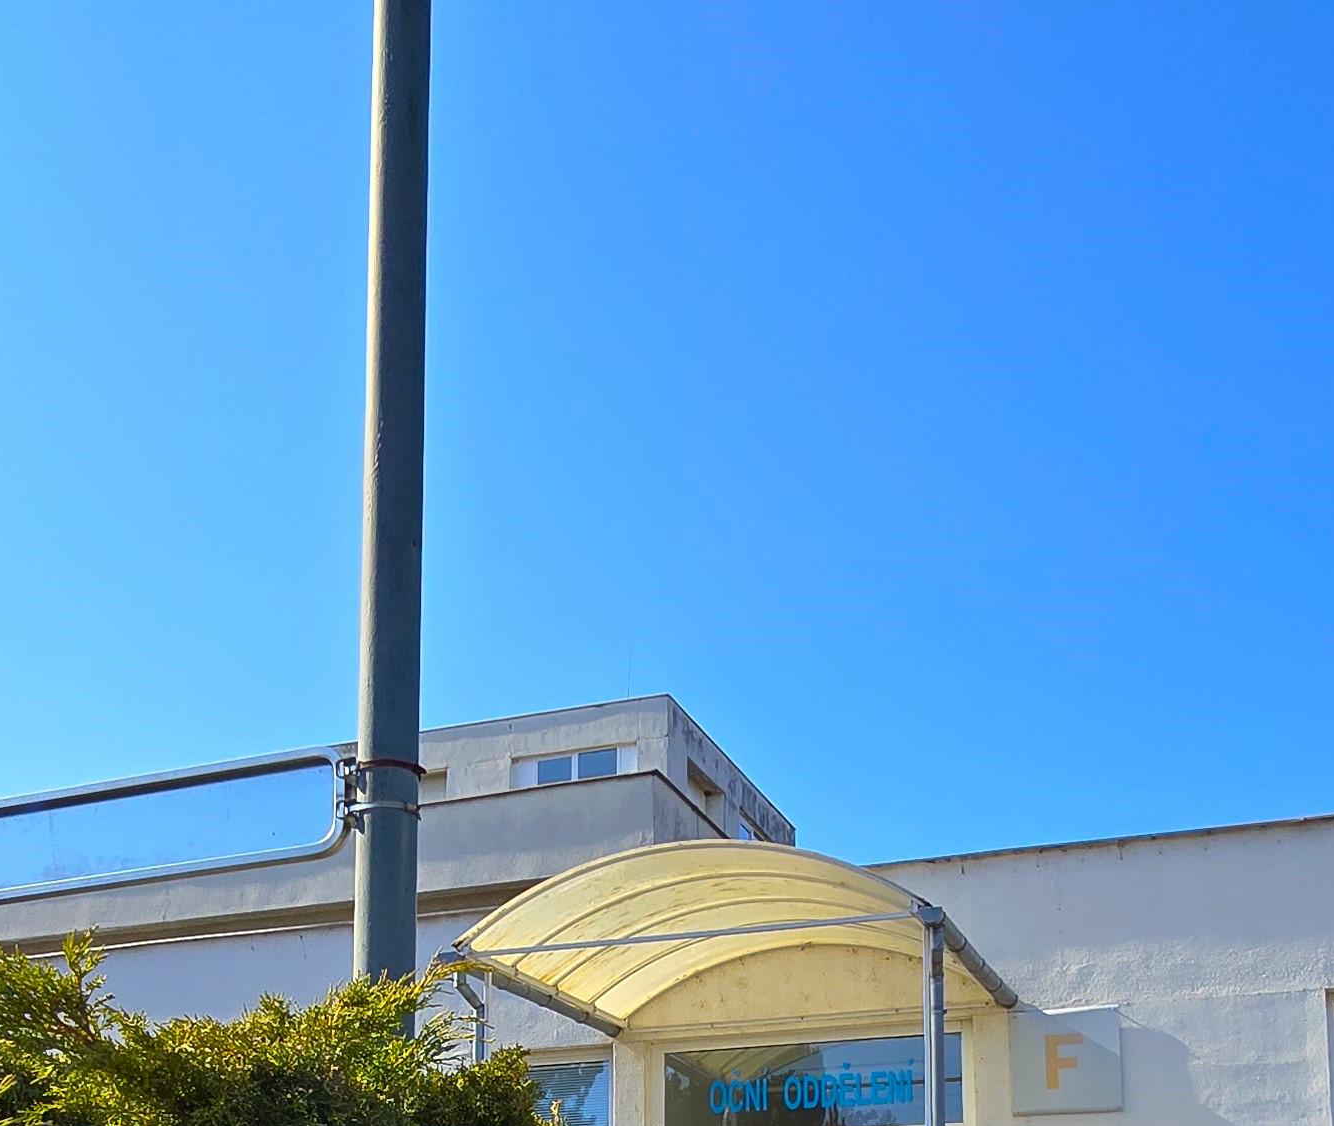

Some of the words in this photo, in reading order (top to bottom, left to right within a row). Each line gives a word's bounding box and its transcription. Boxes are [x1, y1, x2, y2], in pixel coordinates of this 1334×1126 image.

[709, 1069, 769, 1115] OČNÍ
[782, 1058, 914, 1110] ODDĚLENÍ
[1045, 1034, 1083, 1089] F
